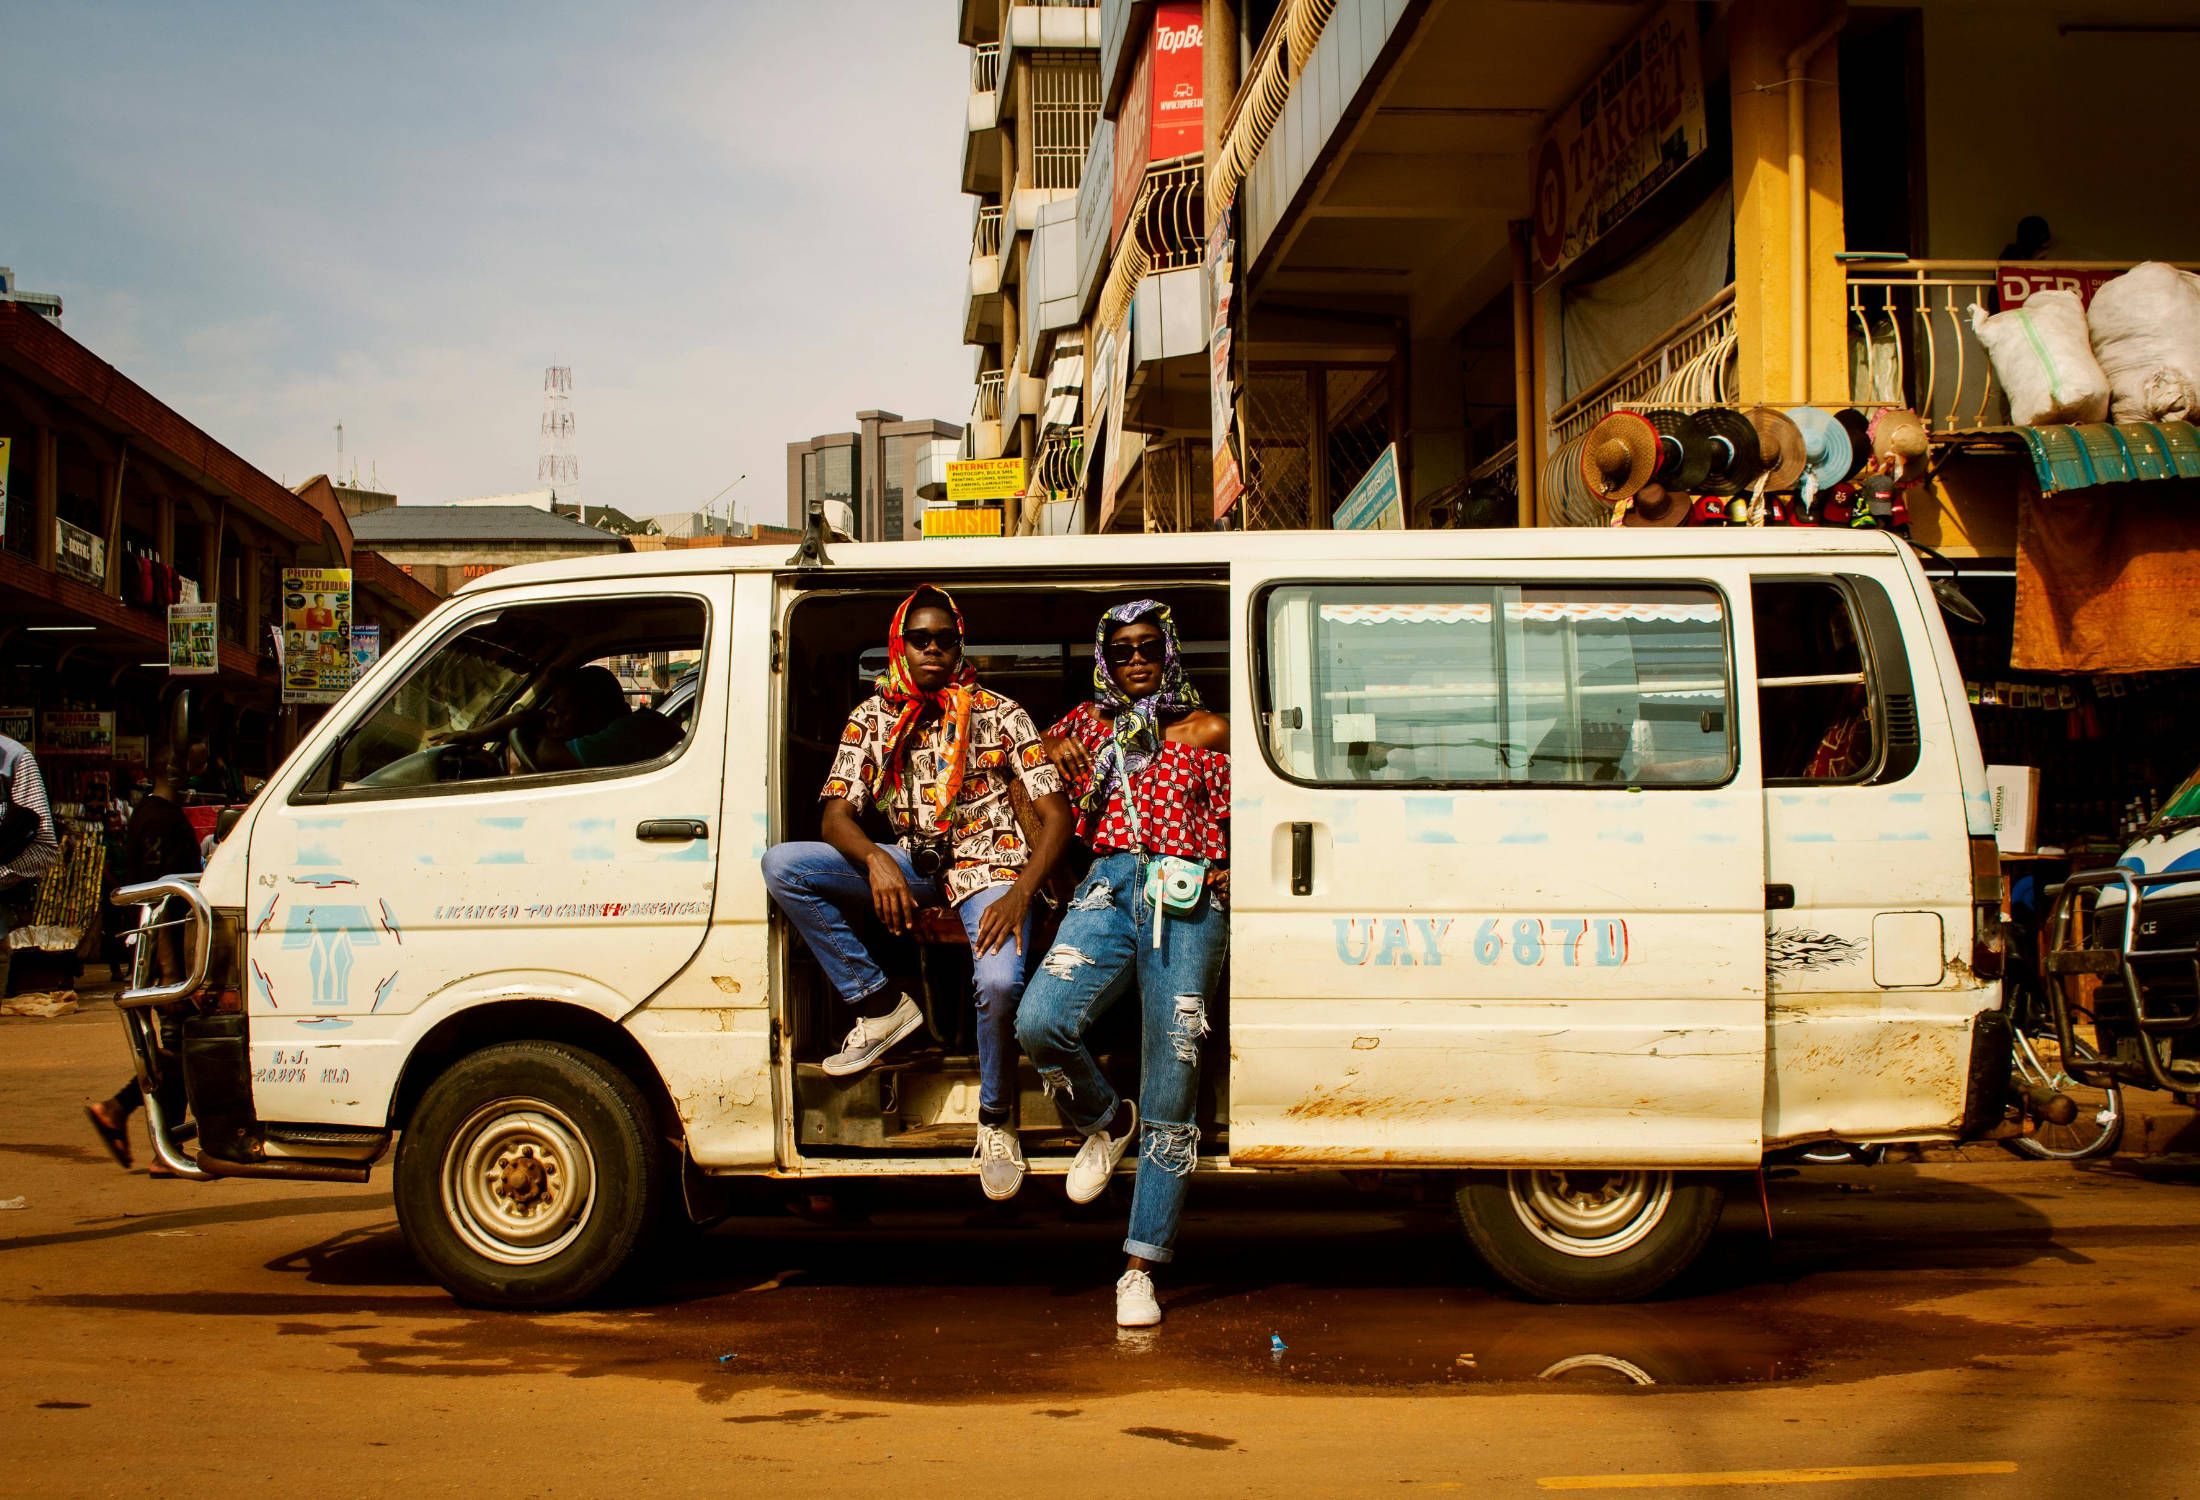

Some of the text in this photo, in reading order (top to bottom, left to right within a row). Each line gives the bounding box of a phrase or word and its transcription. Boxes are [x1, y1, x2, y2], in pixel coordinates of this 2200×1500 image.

[1569, 28, 1687, 193] TARGET
[948, 461, 1021, 471] INTERNET CAFE
[924, 510, 999, 535] TIANSHI
[287, 569, 322, 578] PHOTO
[305, 581, 350, 591] STUDIO
[6, 720, 29, 741] SHOP
[1332, 918, 1629, 966] UAY 687D
